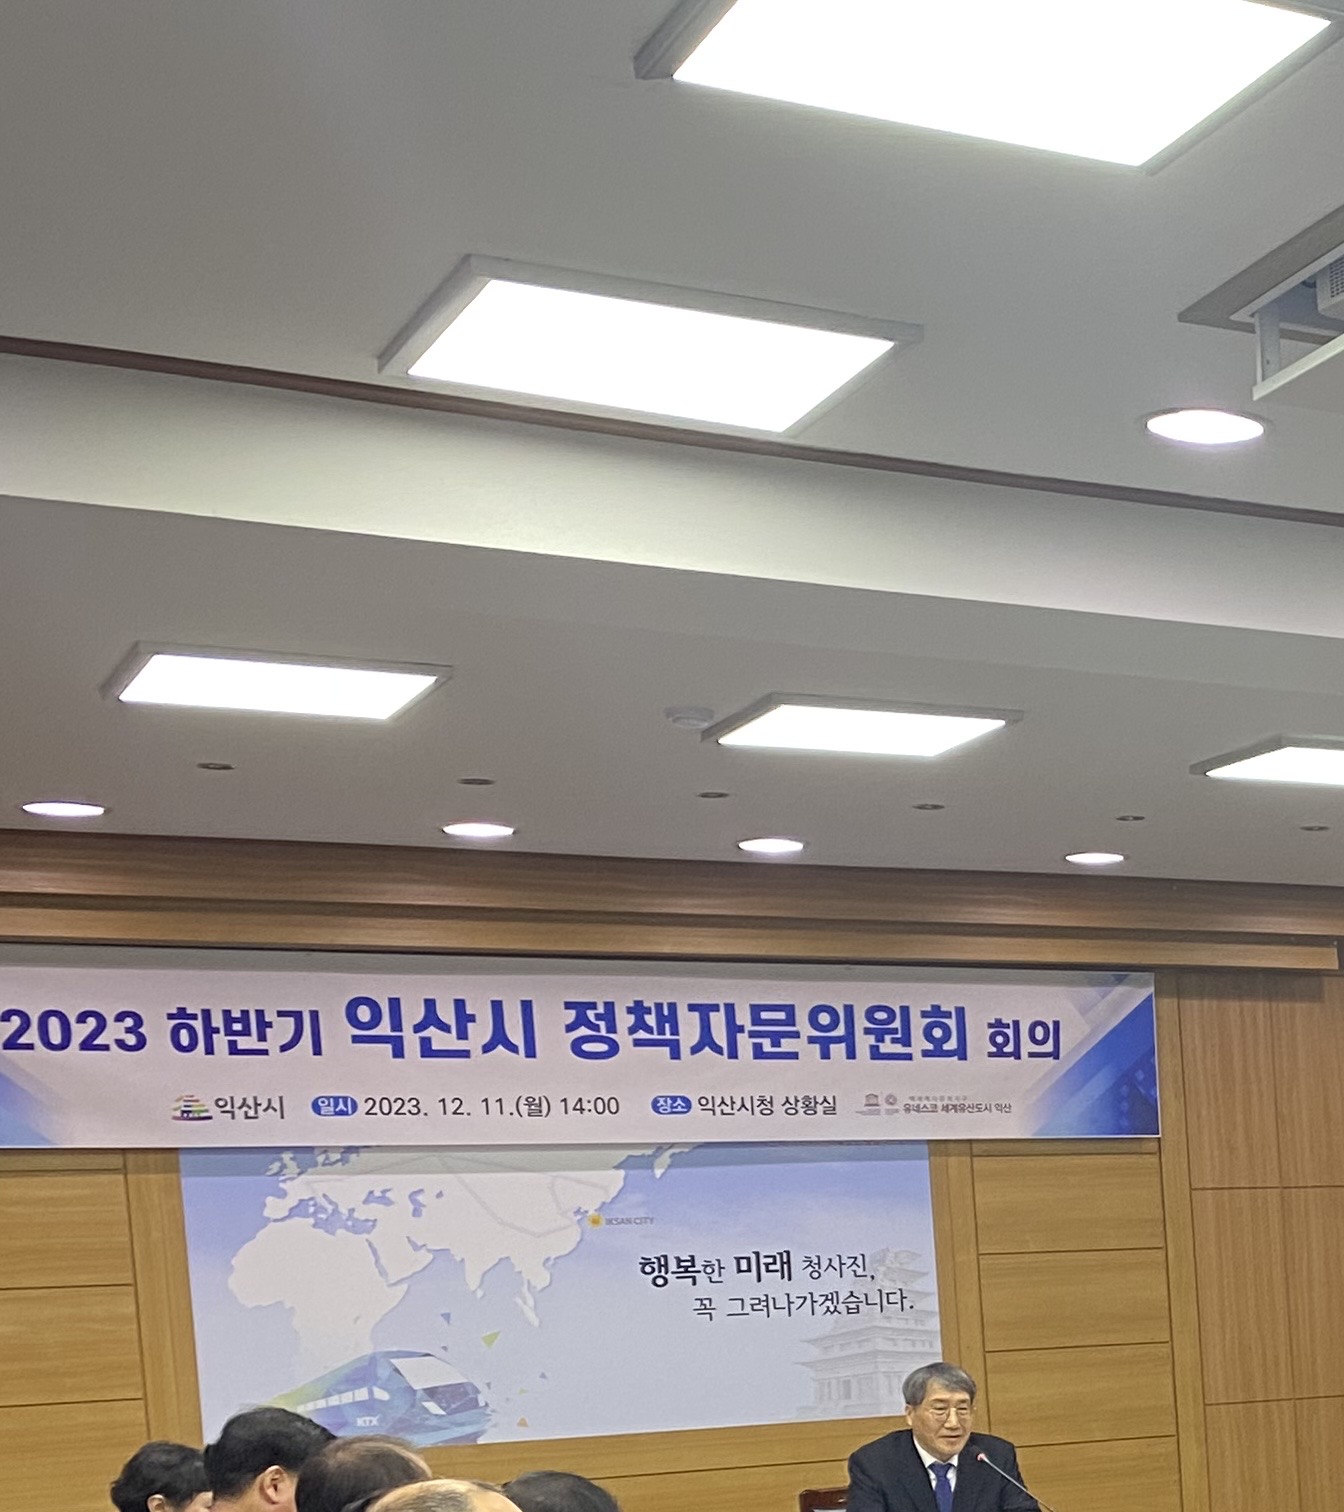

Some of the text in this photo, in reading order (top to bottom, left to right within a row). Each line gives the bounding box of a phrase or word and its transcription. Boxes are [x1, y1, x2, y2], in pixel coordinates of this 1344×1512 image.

[1, 996, 1061, 1062] 2023 하반기 익산시 정책자문위원회 회의
[214, 1095, 285, 1120] 익산시
[317, 1095, 620, 1119] 일시 2023. 12. 11.(월) 14:00
[656, 1094, 838, 1117] 장소 익산시청 상황실
[639, 1250, 876, 1288] 행복한 미래 청사진,
[693, 1288, 915, 1321] 꼭 그려나가겠습니다.
[356, 1415, 379, 1427] KTX
